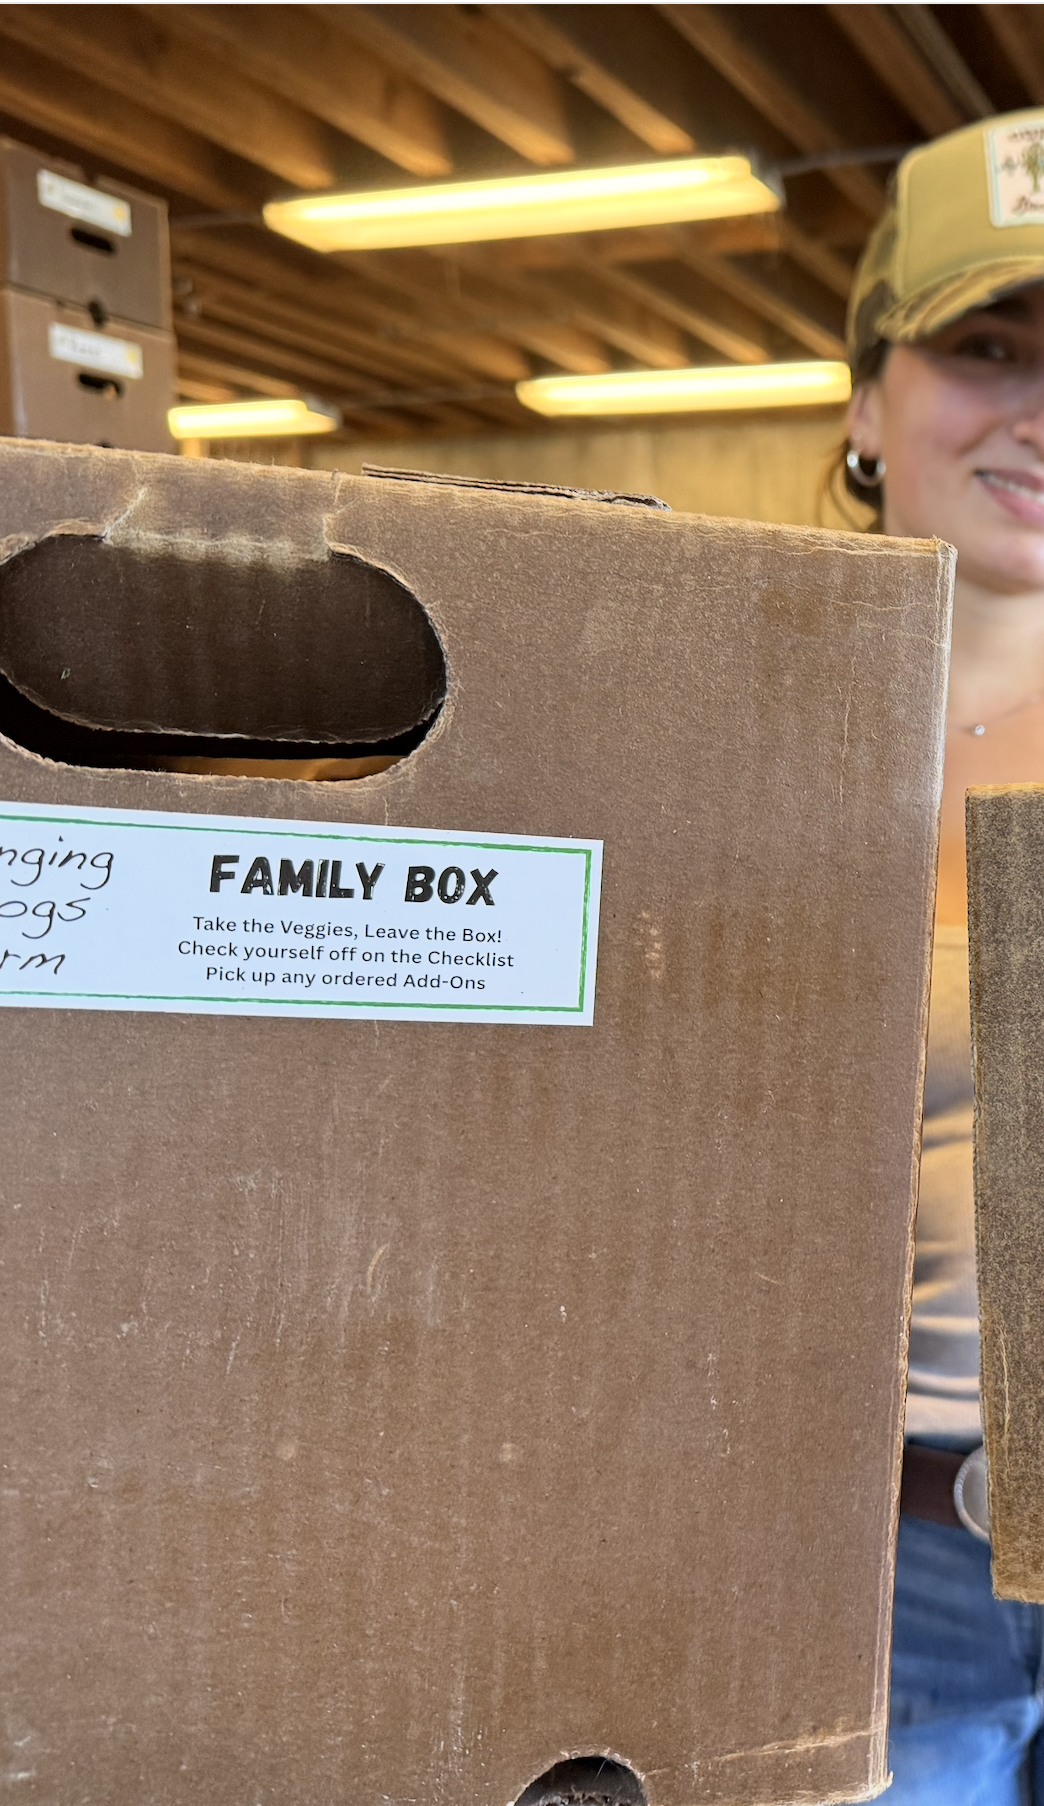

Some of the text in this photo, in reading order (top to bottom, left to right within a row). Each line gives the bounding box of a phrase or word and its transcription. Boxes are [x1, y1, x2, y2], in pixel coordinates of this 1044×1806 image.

[209, 854, 499, 907] FAMILY BOX
[193, 916, 502, 944] Take the Veggies, Leave the Box!
[178, 940, 515, 968] Check yourself off on the Checklist
[206, 966, 486, 990] Pick up any ordered Add-Ons
